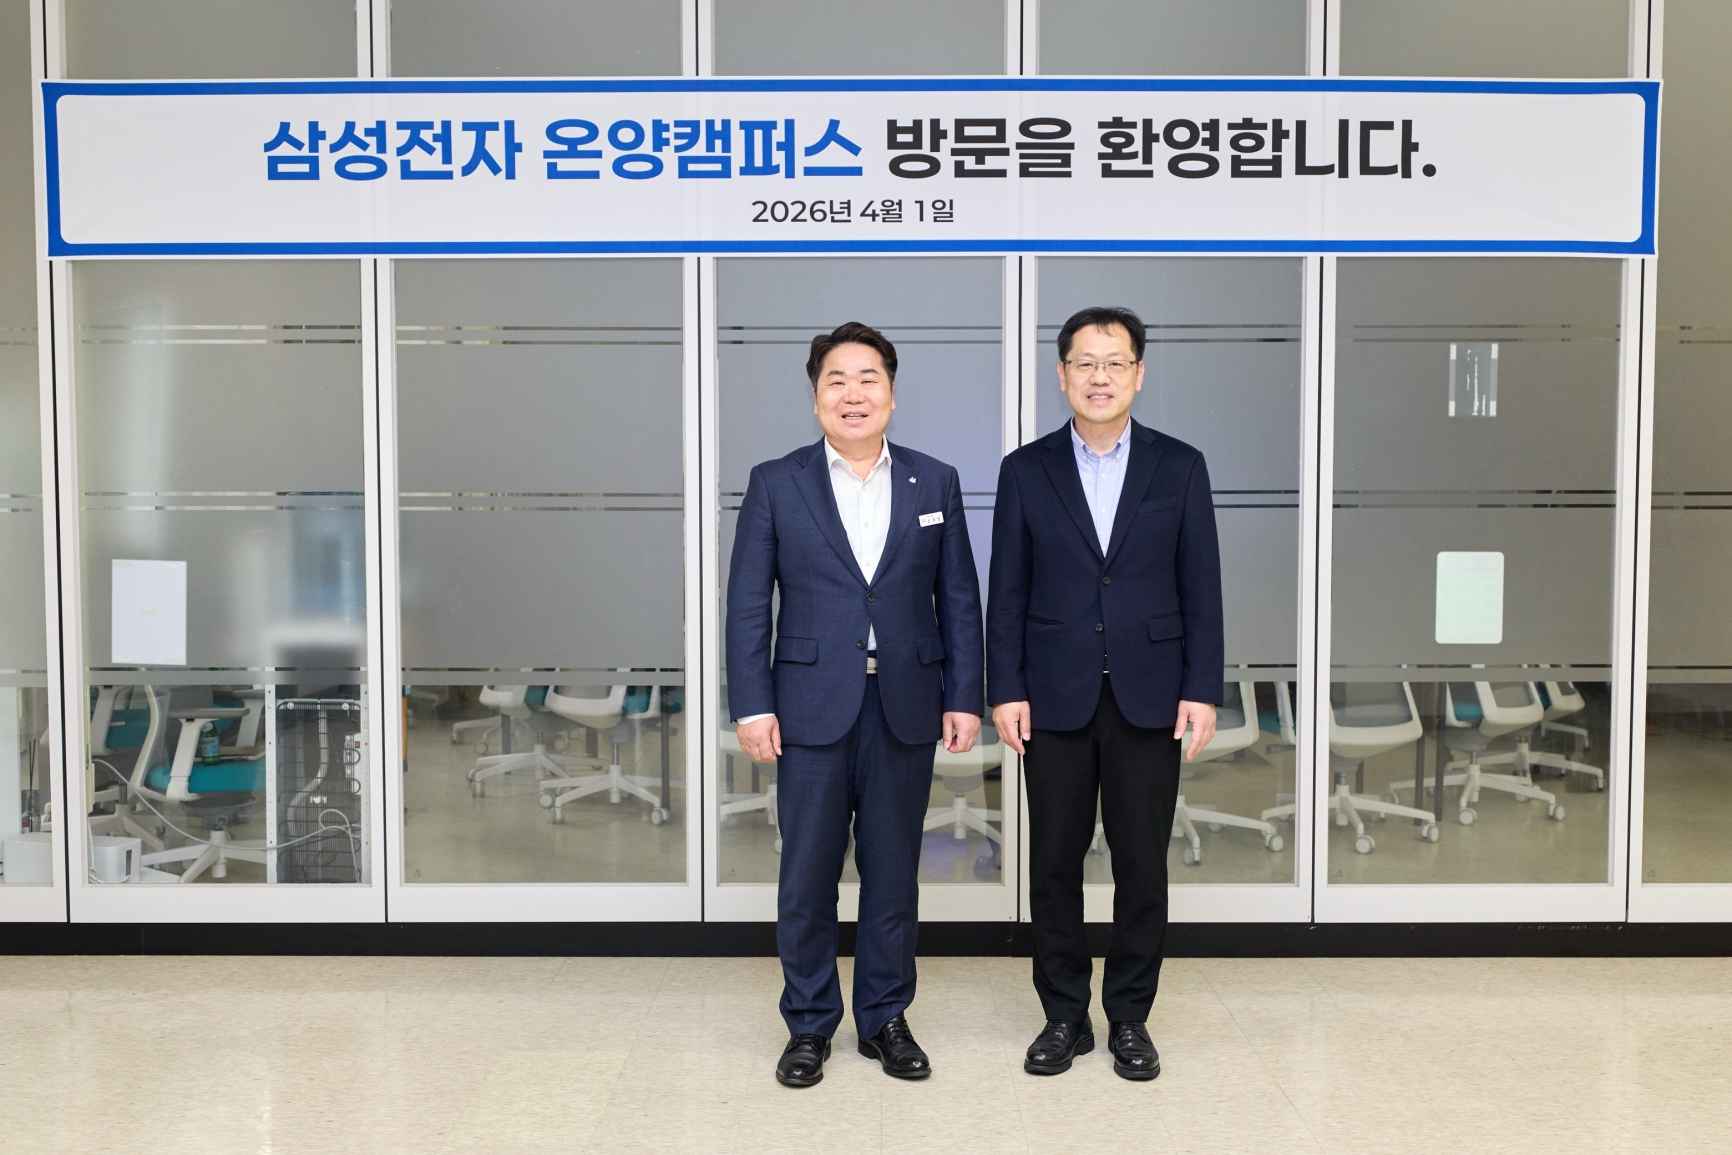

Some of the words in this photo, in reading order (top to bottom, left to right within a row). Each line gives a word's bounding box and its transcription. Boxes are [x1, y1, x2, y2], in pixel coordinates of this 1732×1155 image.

[263, 119, 523, 181] 삼성전자
[543, 118, 863, 180] 온양캠퍼스
[886, 117, 1076, 180] 방문을
[1098, 116, 1437, 180] 환영합니다.
[752, 199, 852, 224] 2026년
[859, 199, 903, 224] 4월
[914, 198, 954, 223] 1일
